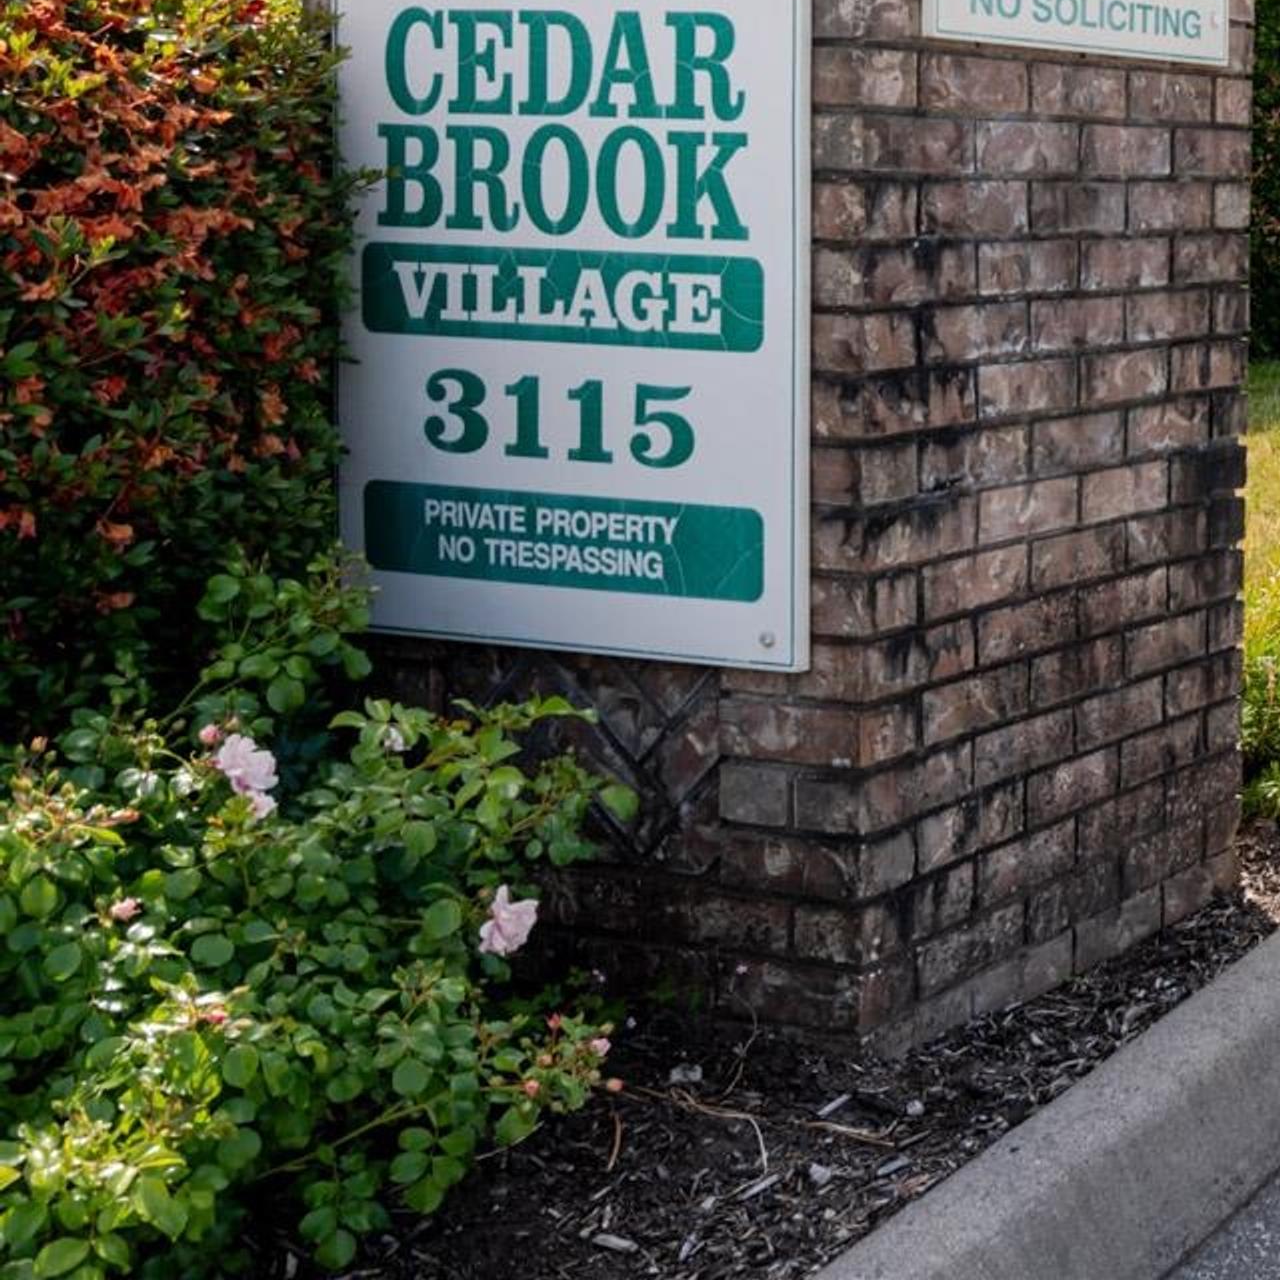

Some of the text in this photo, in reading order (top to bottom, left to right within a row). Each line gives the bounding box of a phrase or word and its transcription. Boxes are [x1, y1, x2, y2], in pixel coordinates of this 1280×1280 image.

[384, 6, 746, 120] CEDAR
[376, 124, 749, 241] BROOK
[392, 260, 722, 335] VILLAGE
[423, 368, 695, 469] 3115
[424, 499, 677, 545] PRIVATE PROPERTY
[437, 535, 665, 580] NO TRESPASSING
